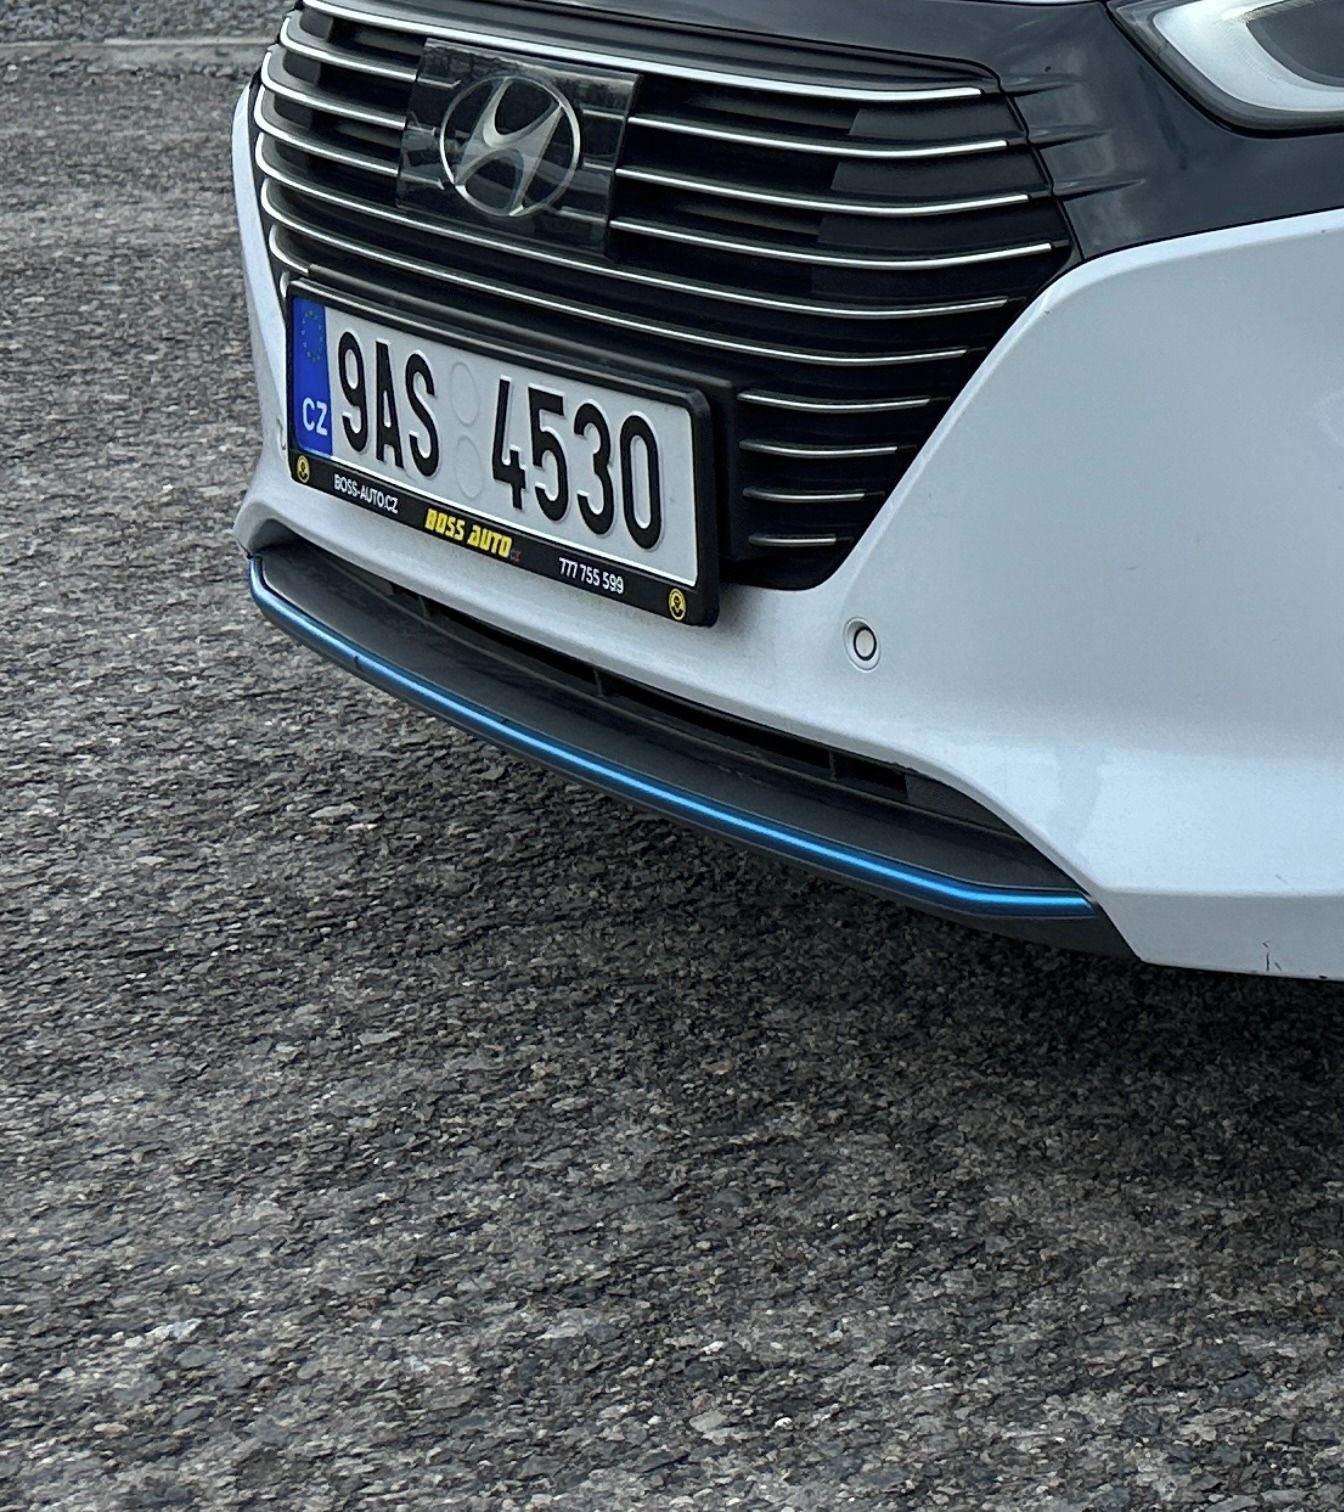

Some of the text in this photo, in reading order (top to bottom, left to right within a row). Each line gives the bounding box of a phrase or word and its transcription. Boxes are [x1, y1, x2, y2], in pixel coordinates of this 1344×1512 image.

[302, 397, 328, 436] CZ
[337, 331, 662, 551] 9AS 4530
[334, 474, 398, 514] BOSS-AUTO.CZ
[425, 508, 512, 558] BOSS AUTO
[559, 557, 624, 594] 777 755 599
